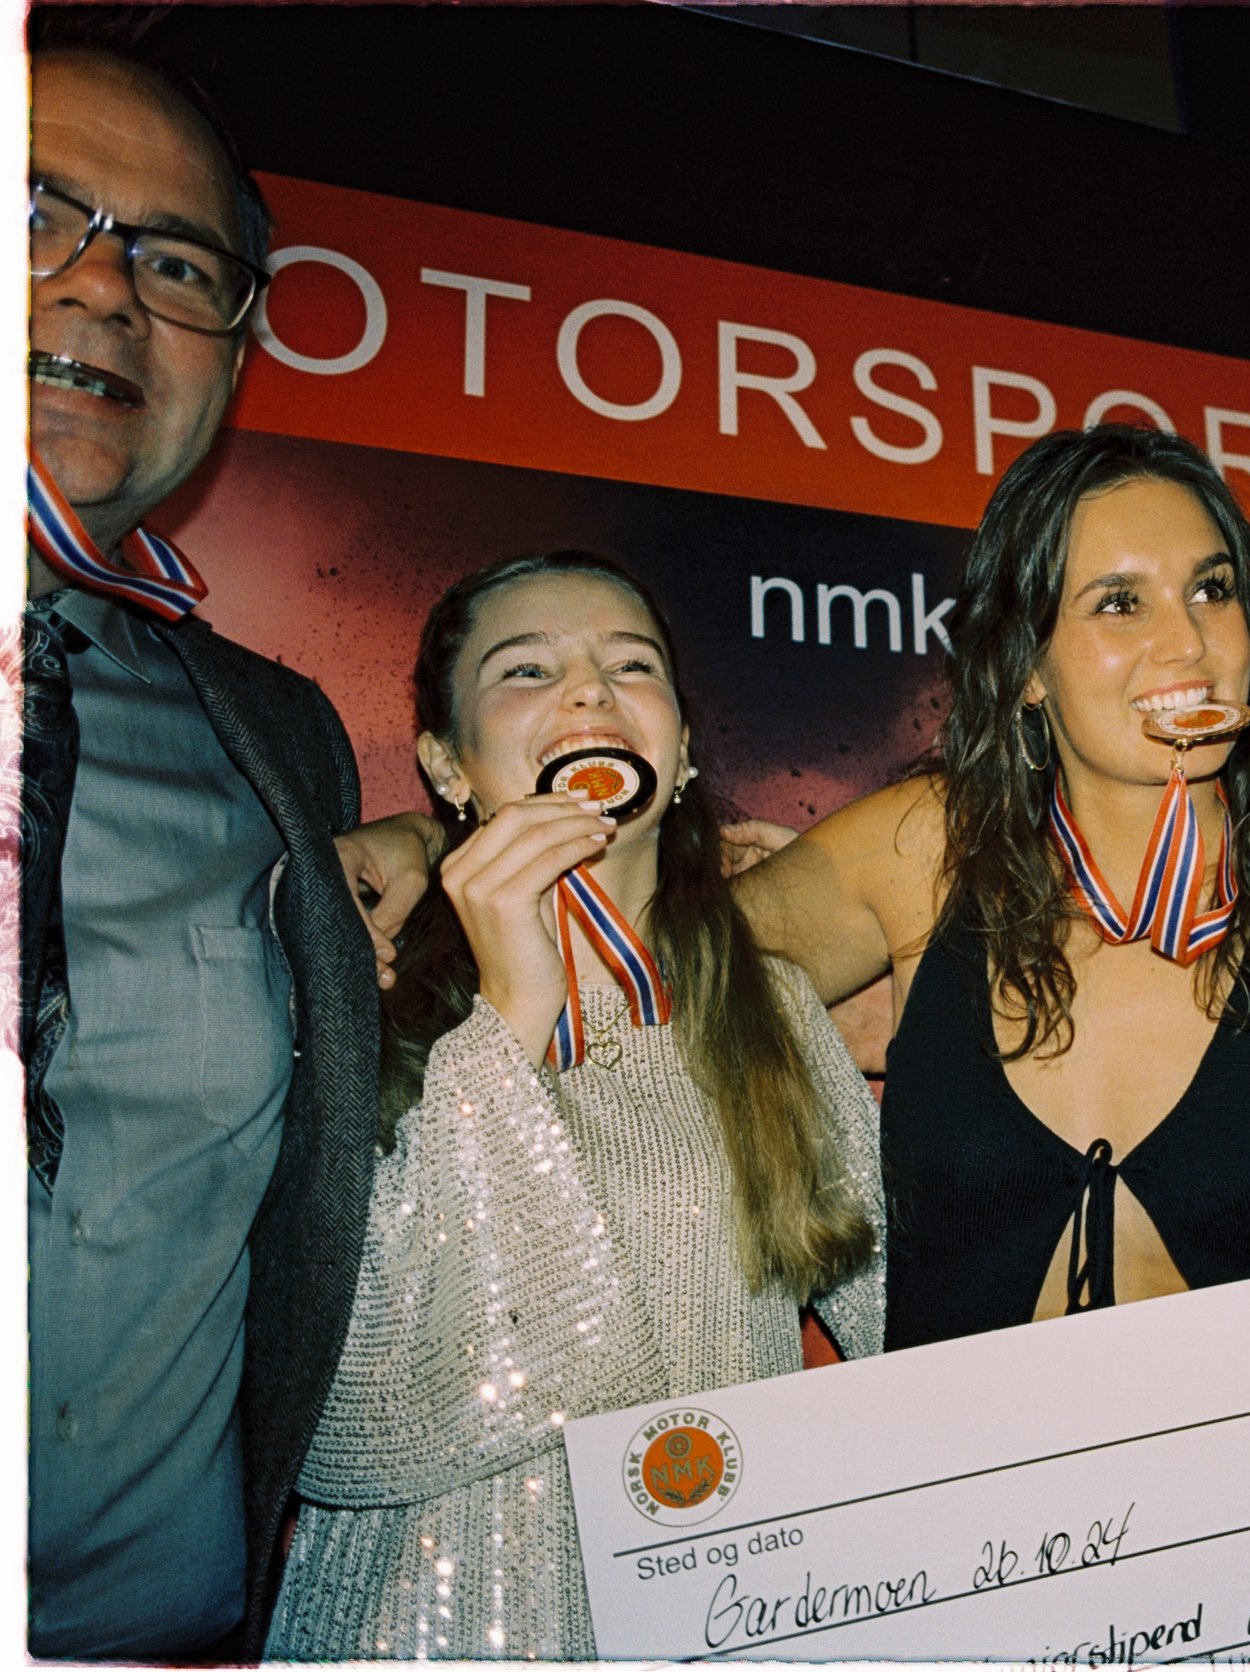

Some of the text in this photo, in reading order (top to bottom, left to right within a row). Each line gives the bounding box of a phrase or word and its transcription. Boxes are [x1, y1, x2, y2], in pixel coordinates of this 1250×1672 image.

[750, 573, 957, 656] nmk
[626, 1412, 738, 1516] NORSK MOTOR KLUBB
[650, 1455, 716, 1487] NMK
[637, 1527, 804, 1580] Sted og dato
[703, 1571, 937, 1650] Gardermoen
